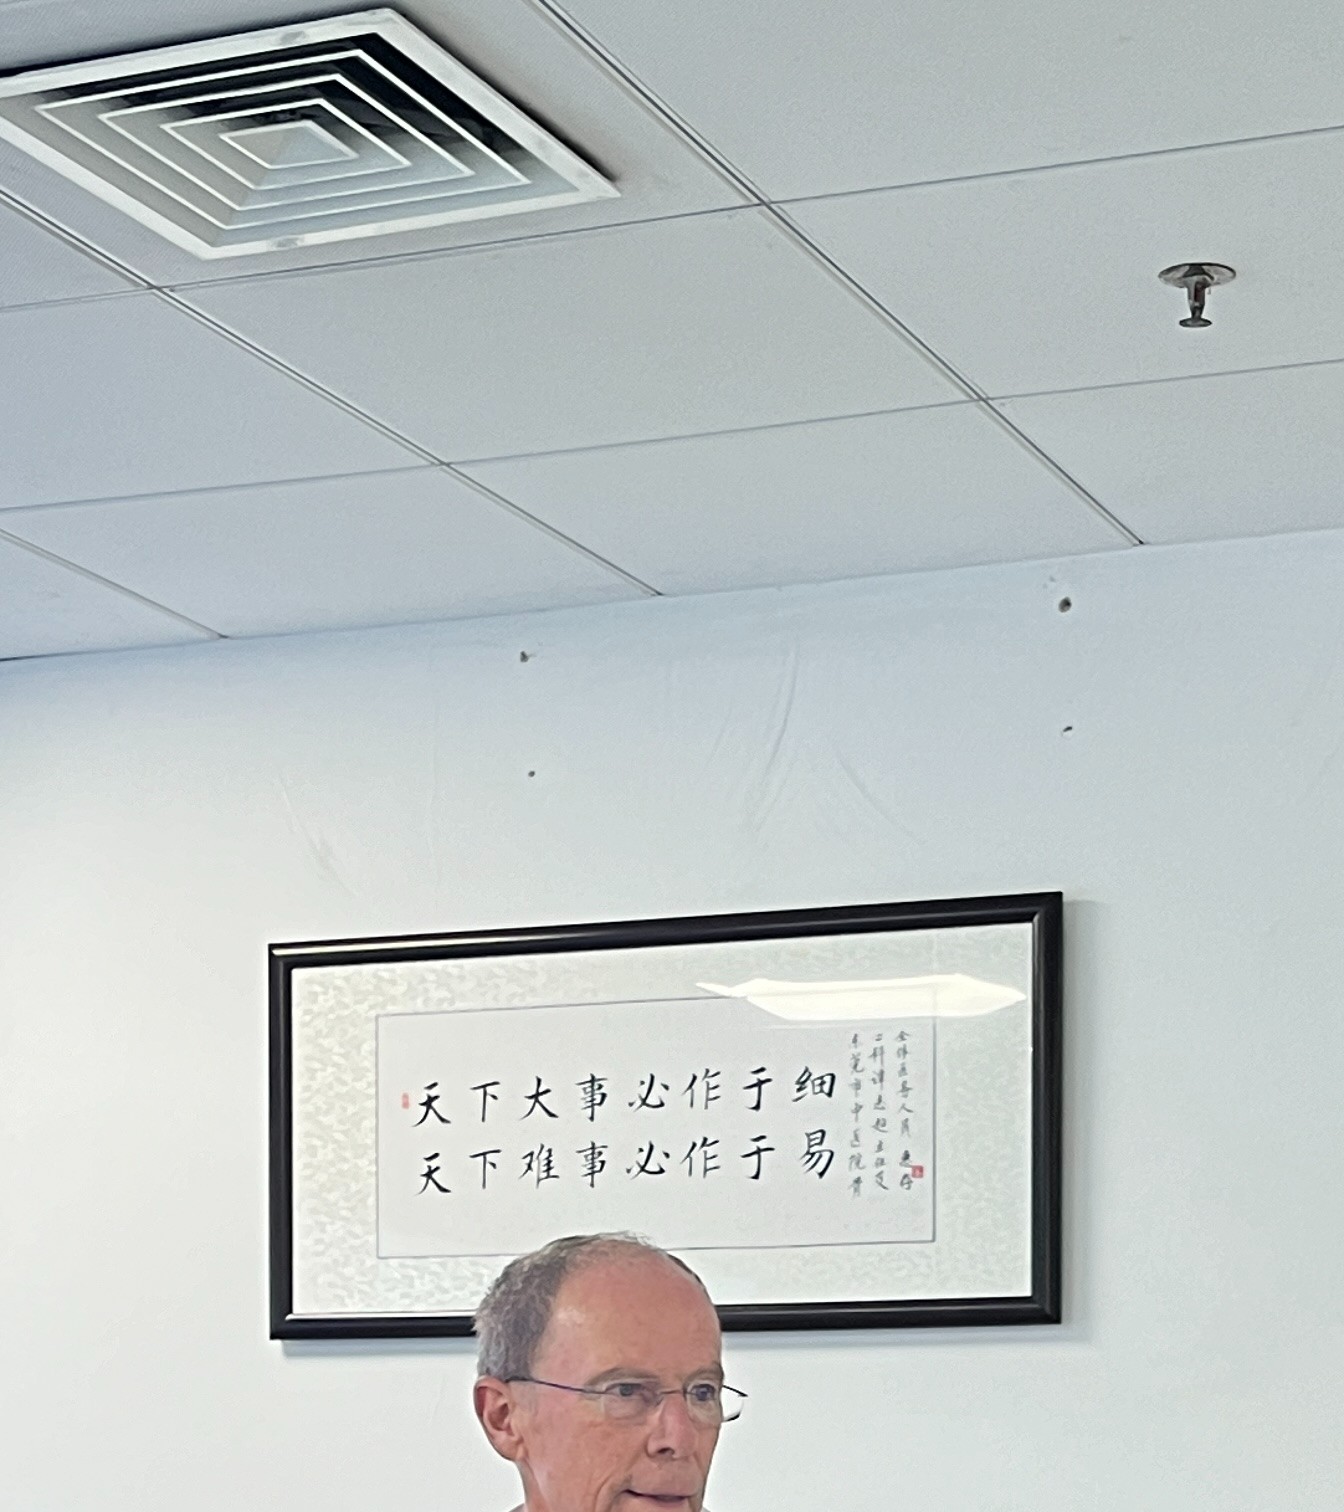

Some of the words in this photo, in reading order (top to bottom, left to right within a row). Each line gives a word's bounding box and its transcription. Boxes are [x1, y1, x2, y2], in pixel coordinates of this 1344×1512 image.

[411, 1065, 837, 1128] 天下大事必作于细
[417, 1129, 835, 1196] 天下难事必作于易
